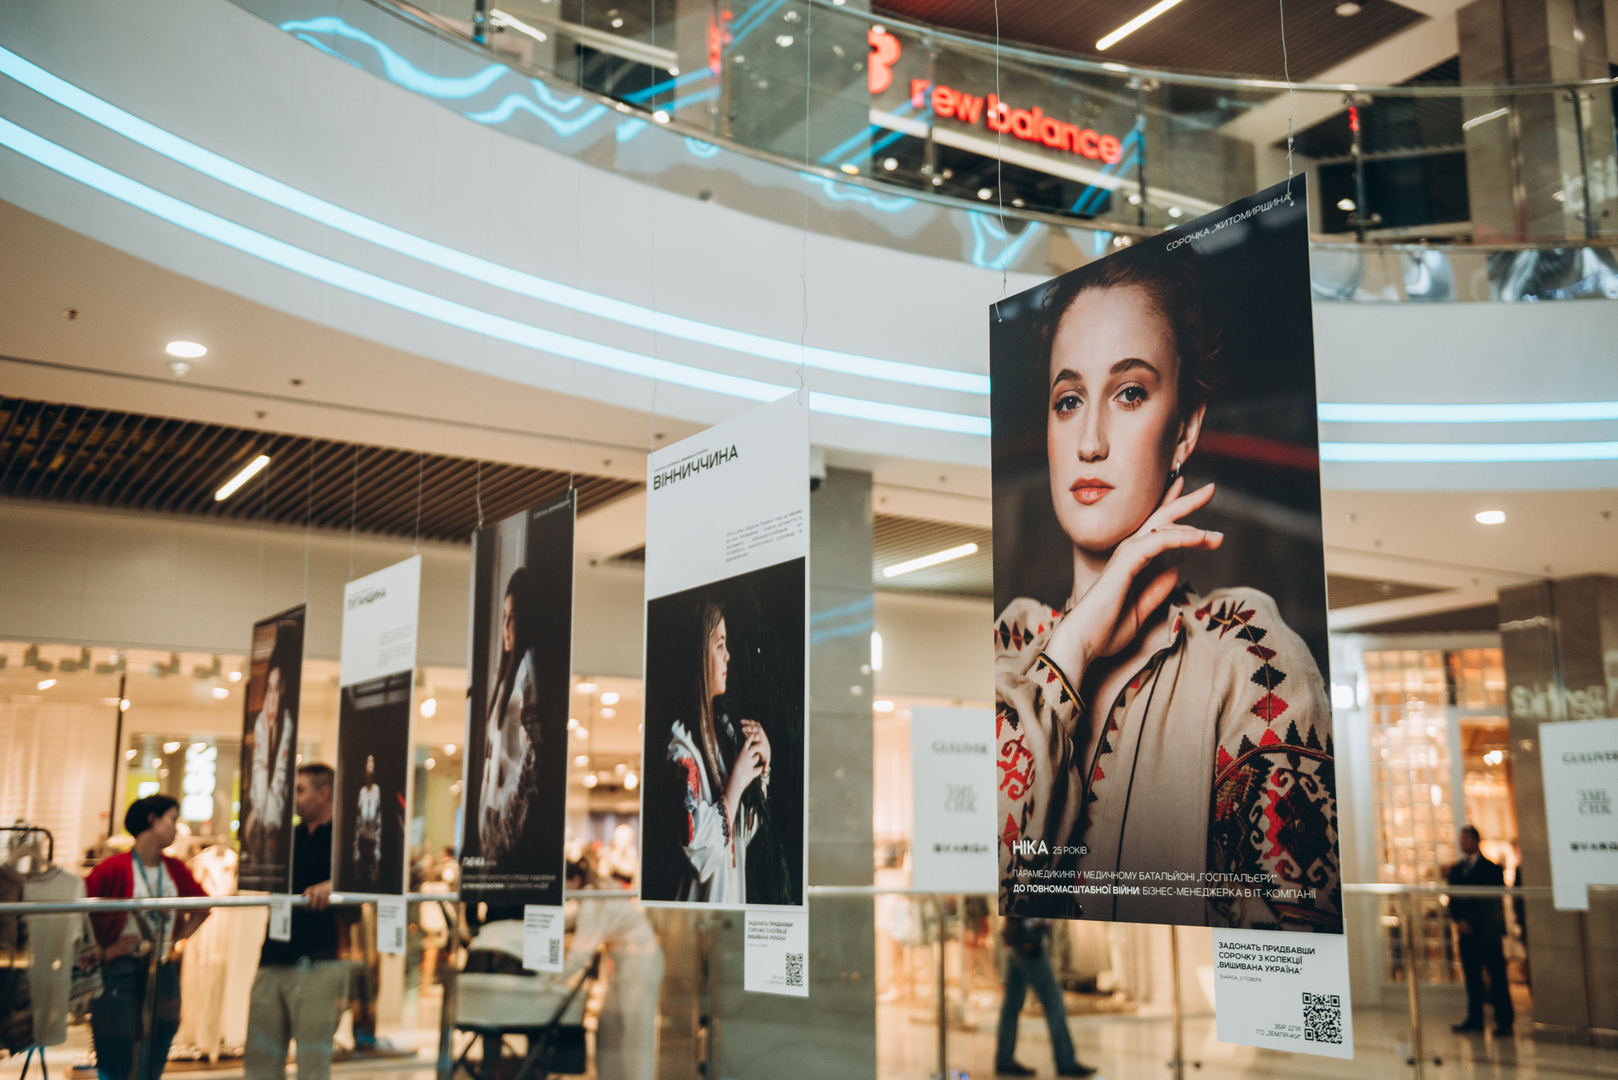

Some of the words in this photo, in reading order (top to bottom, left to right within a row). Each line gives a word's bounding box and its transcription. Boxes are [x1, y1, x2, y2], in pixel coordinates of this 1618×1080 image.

[911, 78, 984, 125] new
[986, 93, 1123, 165] balance
[1166, 227, 1211, 252] СОРОЧКА
[653, 444, 739, 491] ВІННИЧЧИНА
[1012, 840, 1049, 855] НІКА
[1052, 846, 1063, 855] 25
[1063, 846, 1088, 855] РОКІВ
[1012, 869, 1076, 879] ПАРАМЕДИКИНЯ
[1077, 871, 1082, 879] У
[1083, 870, 1137, 880] МЕДИЧНОМУ
[1138, 871, 1195, 881] БАТАЛЬЙОНІ
[1013, 884, 1025, 893] ДО
[1026, 884, 1111, 894] ПОВНОМАСШТАБНОЇ
[1142, 886, 1243, 898] БІЗНЕС-МЕНЕДЖЕРКА
[1244, 888, 1252, 897] В
[1218, 941, 1261, 951] ЗАДОНАТЬ
[1262, 945, 1315, 955] ПРИДБАВШИ
[1218, 952, 1257, 961] СОРОЧКУ
[1264, 955, 1303, 965] КОЛЕКЦІЇ
